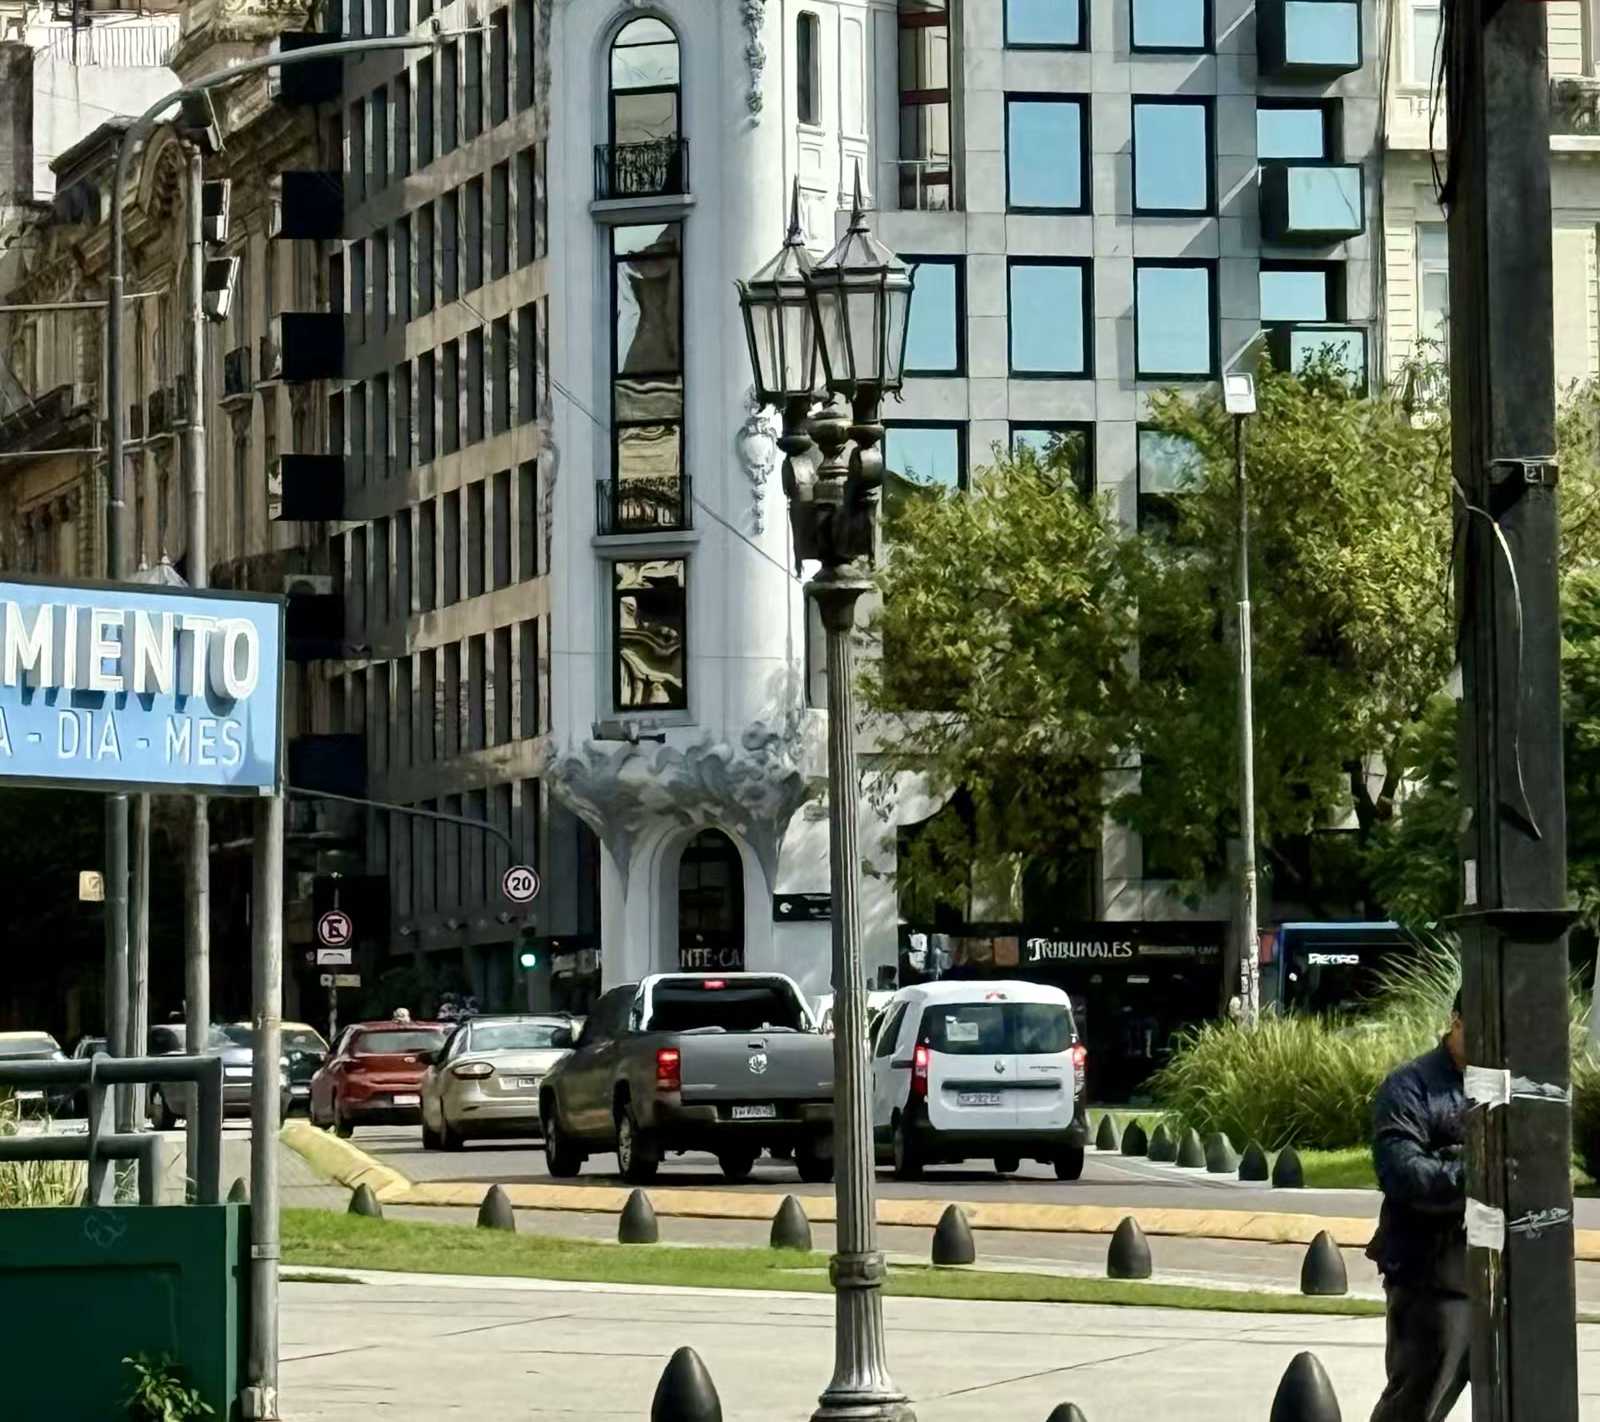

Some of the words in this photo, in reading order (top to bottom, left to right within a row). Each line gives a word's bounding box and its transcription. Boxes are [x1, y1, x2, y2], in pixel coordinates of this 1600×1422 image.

[3, 600, 260, 700] MIENTO
[57, 709, 122, 762] DIA
[165, 714, 242, 766] MES
[512, 876, 532, 891] 20
[1026, 937, 1133, 961] TRIBUNALES
